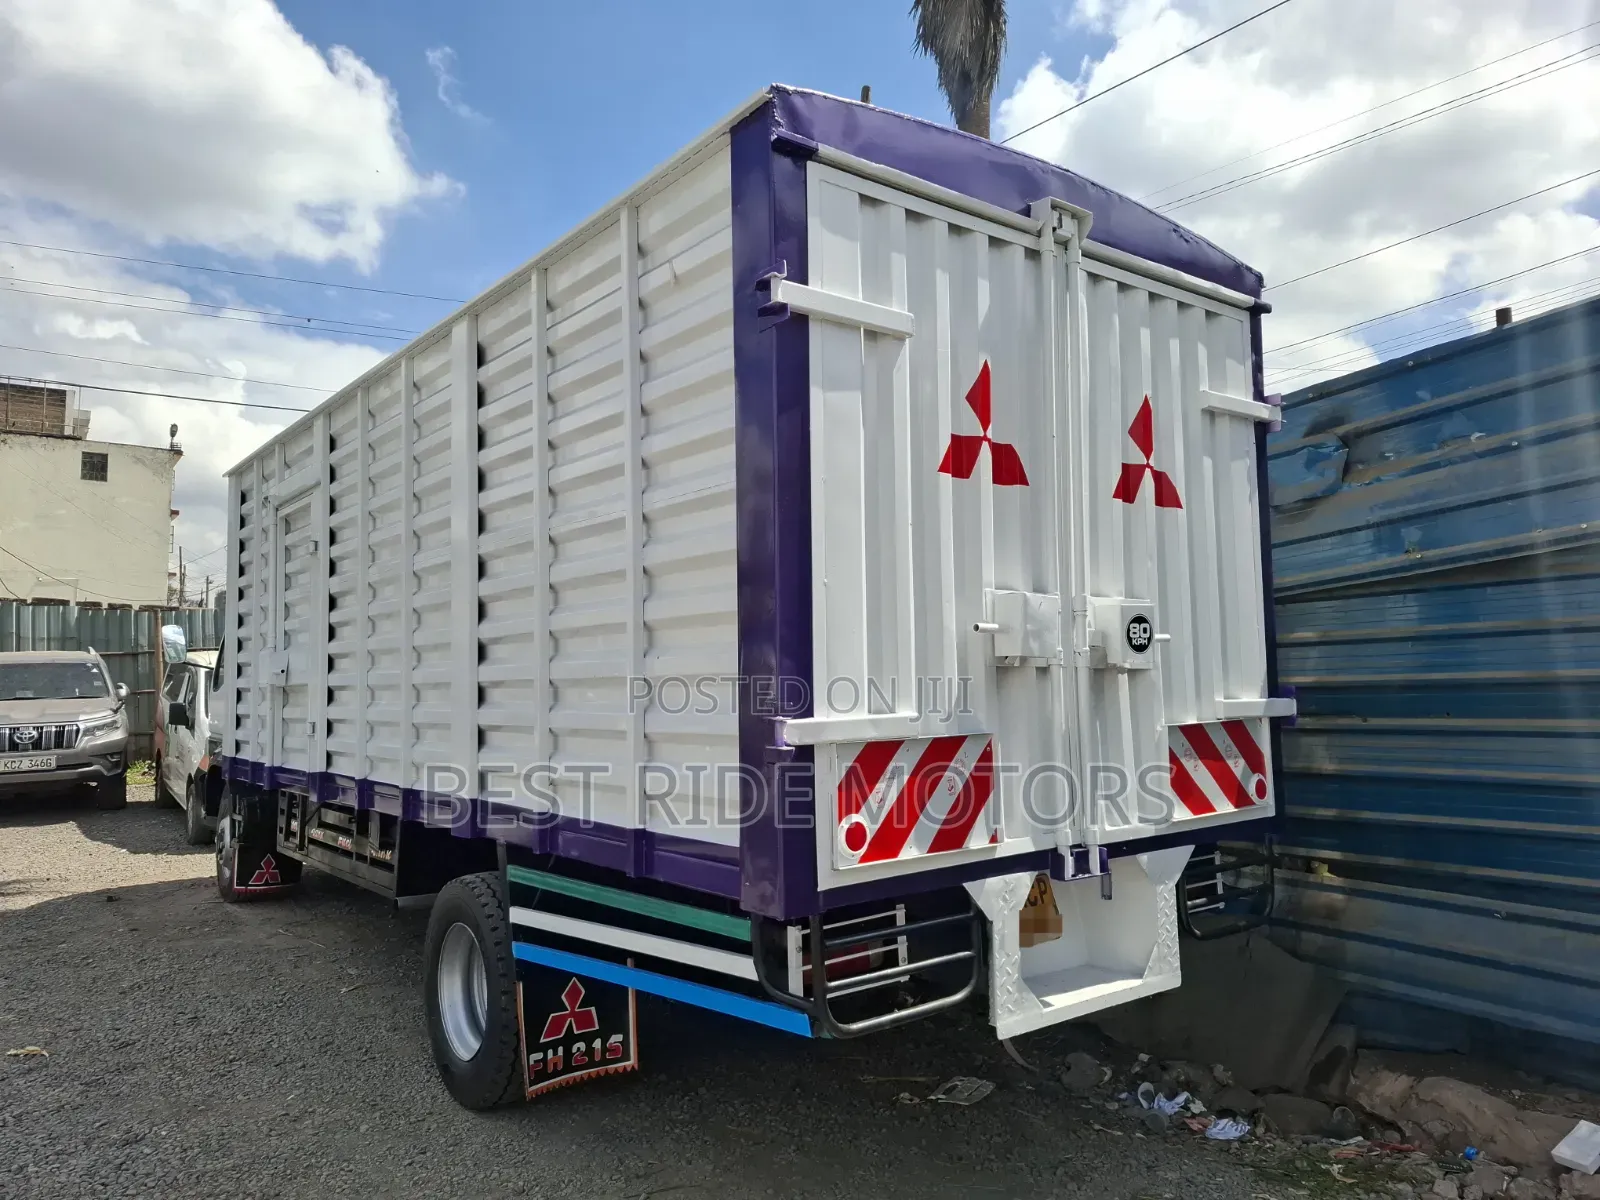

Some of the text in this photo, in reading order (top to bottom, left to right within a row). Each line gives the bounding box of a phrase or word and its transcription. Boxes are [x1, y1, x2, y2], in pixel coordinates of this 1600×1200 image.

[1129, 622, 1150, 638] 80
[1131, 637, 1148, 646] KPH
[3, 757, 52, 770] KCZ 346G
[528, 1033, 624, 1080] FH 215
